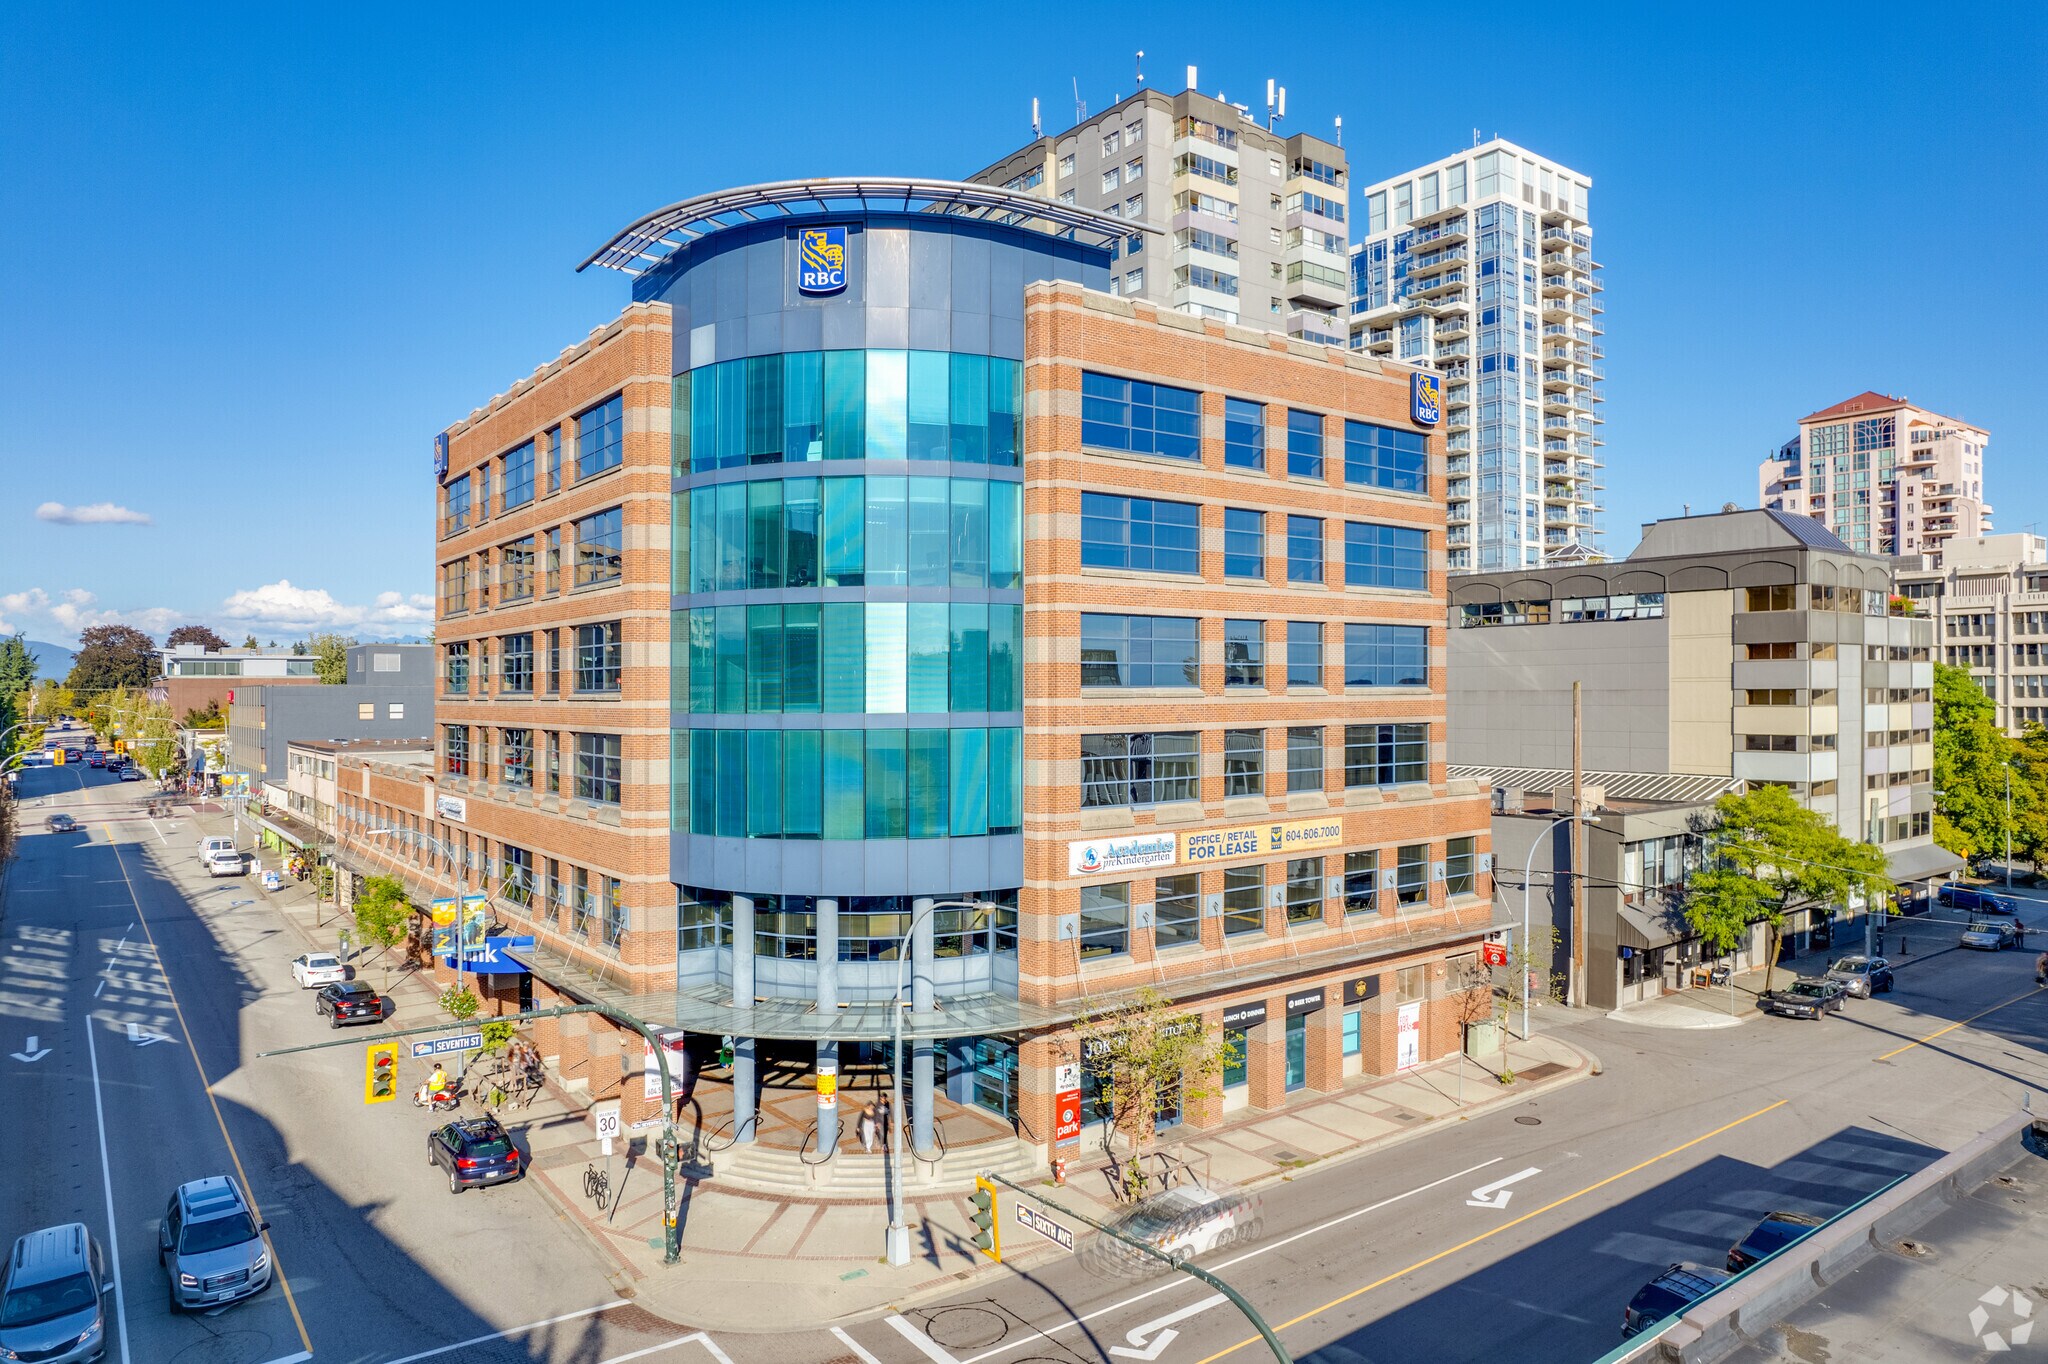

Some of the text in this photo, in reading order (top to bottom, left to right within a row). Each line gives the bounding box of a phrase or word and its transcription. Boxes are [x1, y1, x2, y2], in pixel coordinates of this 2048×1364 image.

[804, 271, 841, 286] RBC
[1419, 407, 1438, 420] RBC
[1189, 834, 1220, 845] OFFICE
[1228, 831, 1257, 841] RETAIL
[1286, 826, 1340, 841] 604.606.7000
[1103, 838, 1174, 858] Academics
[1189, 841, 1257, 859] FOR LEASE
[1223, 1008, 1265, 1022] LUNCH DINNER
[437, 1039, 469, 1051] SEVENTH
[471, 1036, 479, 1046] ST
[600, 1117, 616, 1132] 30
[1057, 1121, 1079, 1138] park
[1035, 1216, 1056, 1239] SIXTH
[1057, 1229, 1071, 1247] AVE
